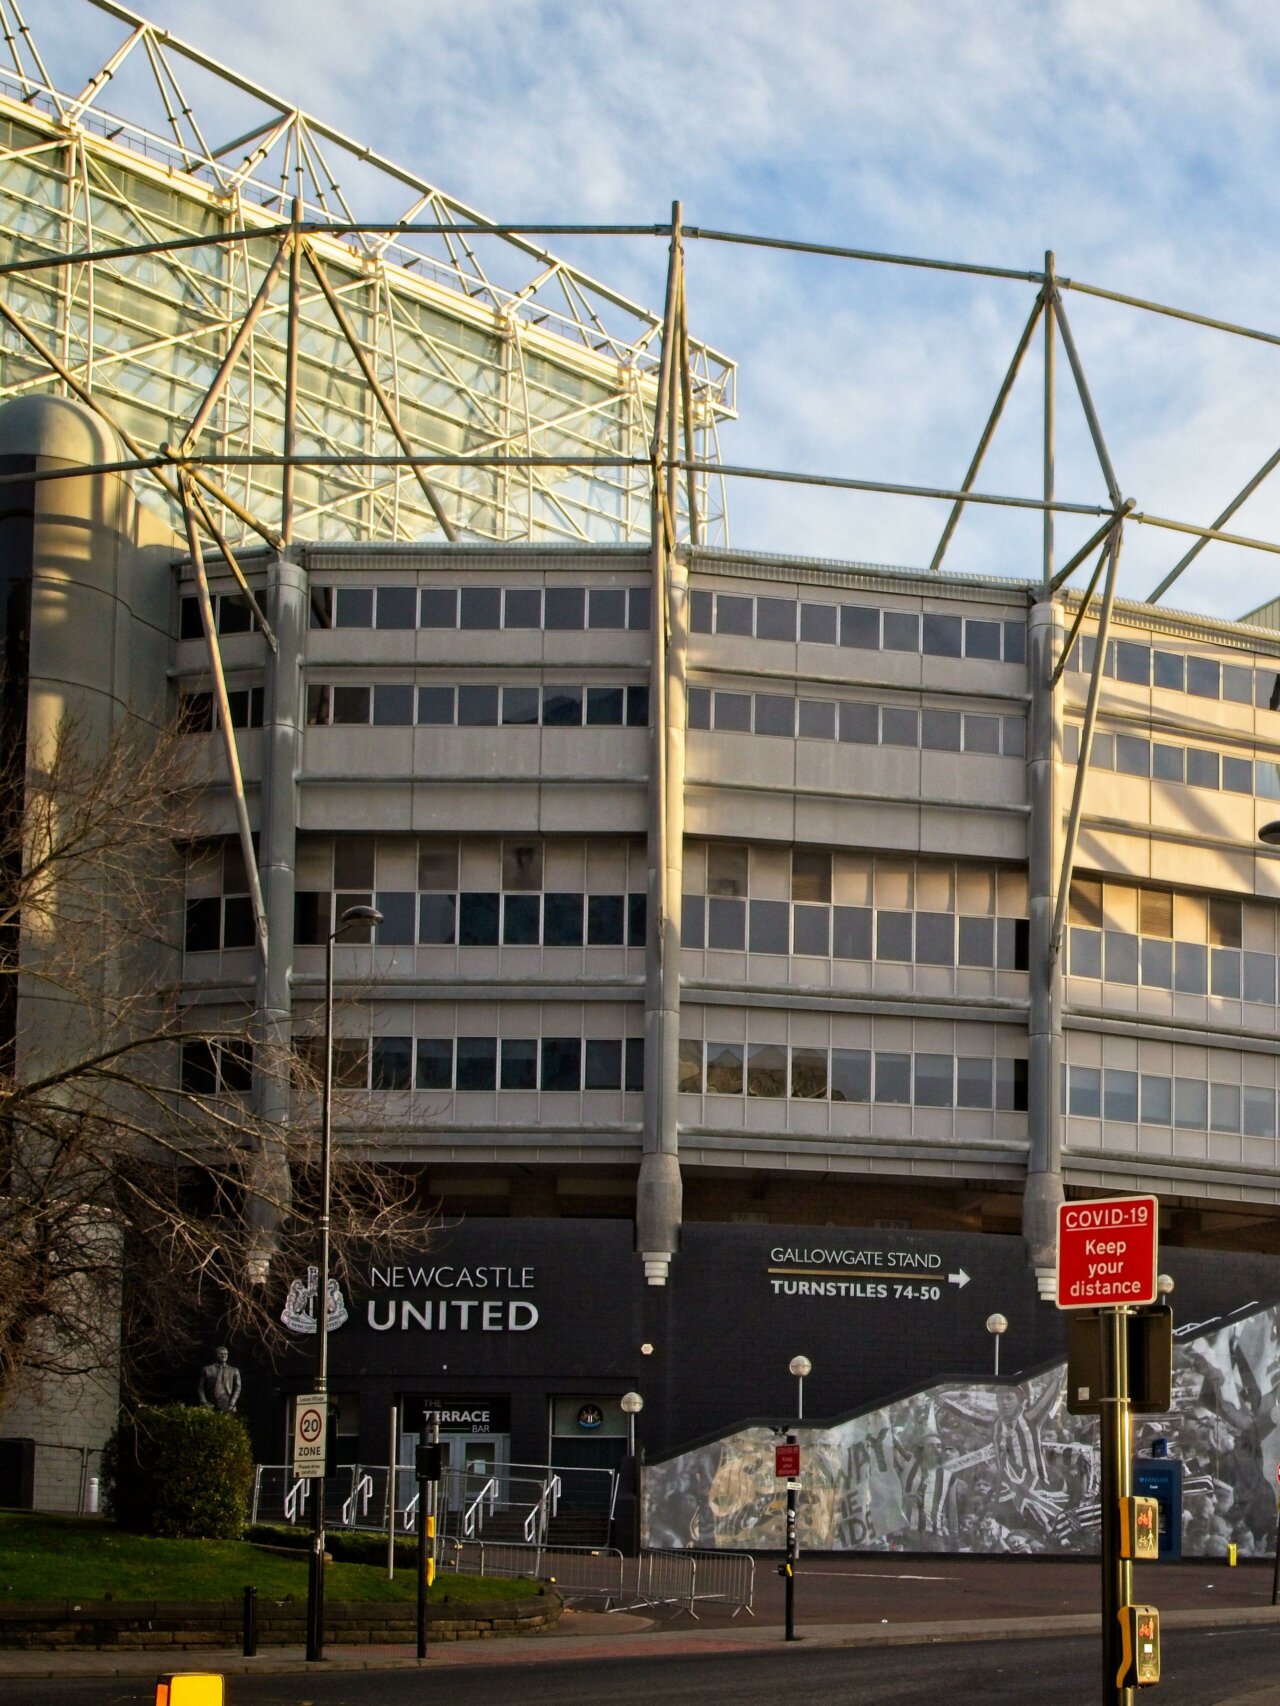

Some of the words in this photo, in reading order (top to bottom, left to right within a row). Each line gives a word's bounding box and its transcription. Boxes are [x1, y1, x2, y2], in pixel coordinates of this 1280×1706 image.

[1066, 1207, 1148, 1228] COVID-19
[1086, 1240, 1126, 1256] Keep
[771, 1248, 883, 1266] GALLOWGATE
[887, 1252, 941, 1268] STAND
[371, 1267, 535, 1288] NEWCASTLE
[1088, 1262, 1124, 1278] your
[770, 1280, 887, 1298] TURNSTILES
[893, 1285, 940, 1300] 74-50
[1070, 1280, 1141, 1297] distance
[367, 1300, 539, 1331] UNITED
[424, 1400, 442, 1408] THE
[304, 1419, 319, 1433] 20
[472, 1425, 490, 1433] BAR
[299, 1447, 321, 1457] ZONE
